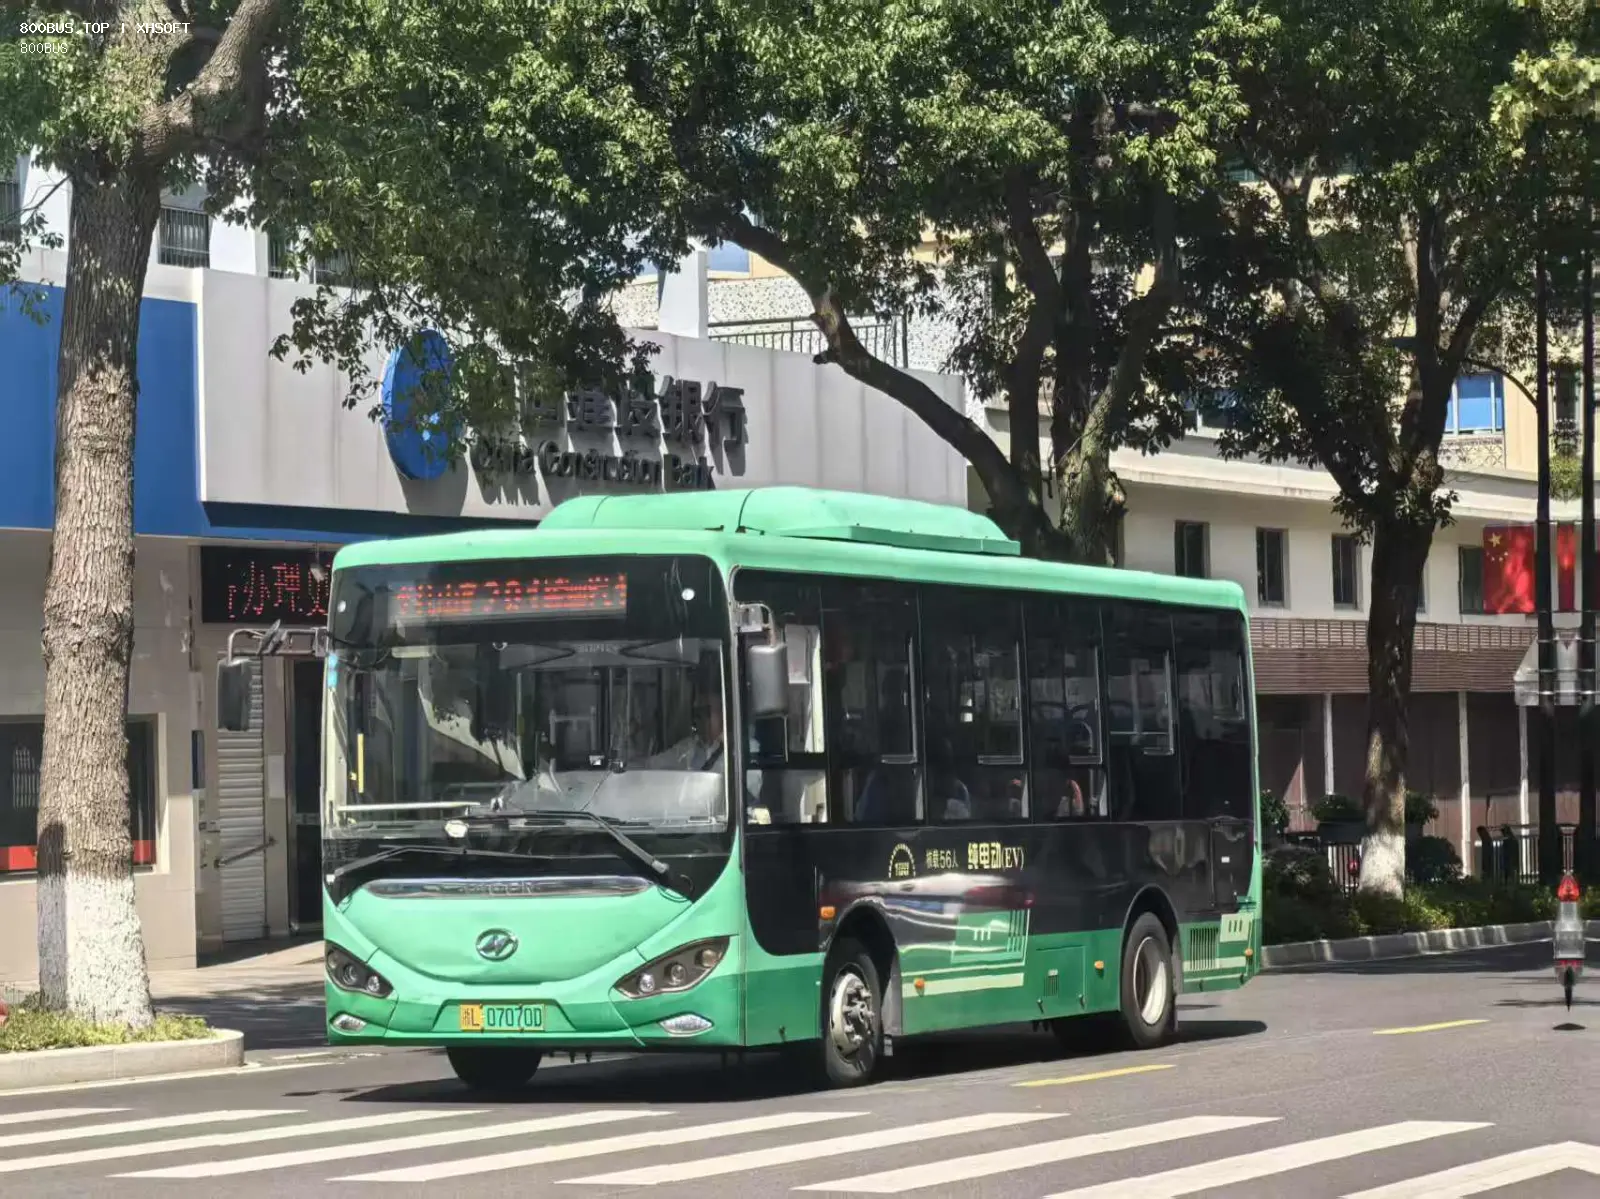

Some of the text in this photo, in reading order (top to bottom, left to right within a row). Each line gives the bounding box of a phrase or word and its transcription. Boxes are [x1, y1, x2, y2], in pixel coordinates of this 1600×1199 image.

[967, 841, 1025, 871] 纯电动(EV)
[487, 1006, 542, 1027] 07070D
